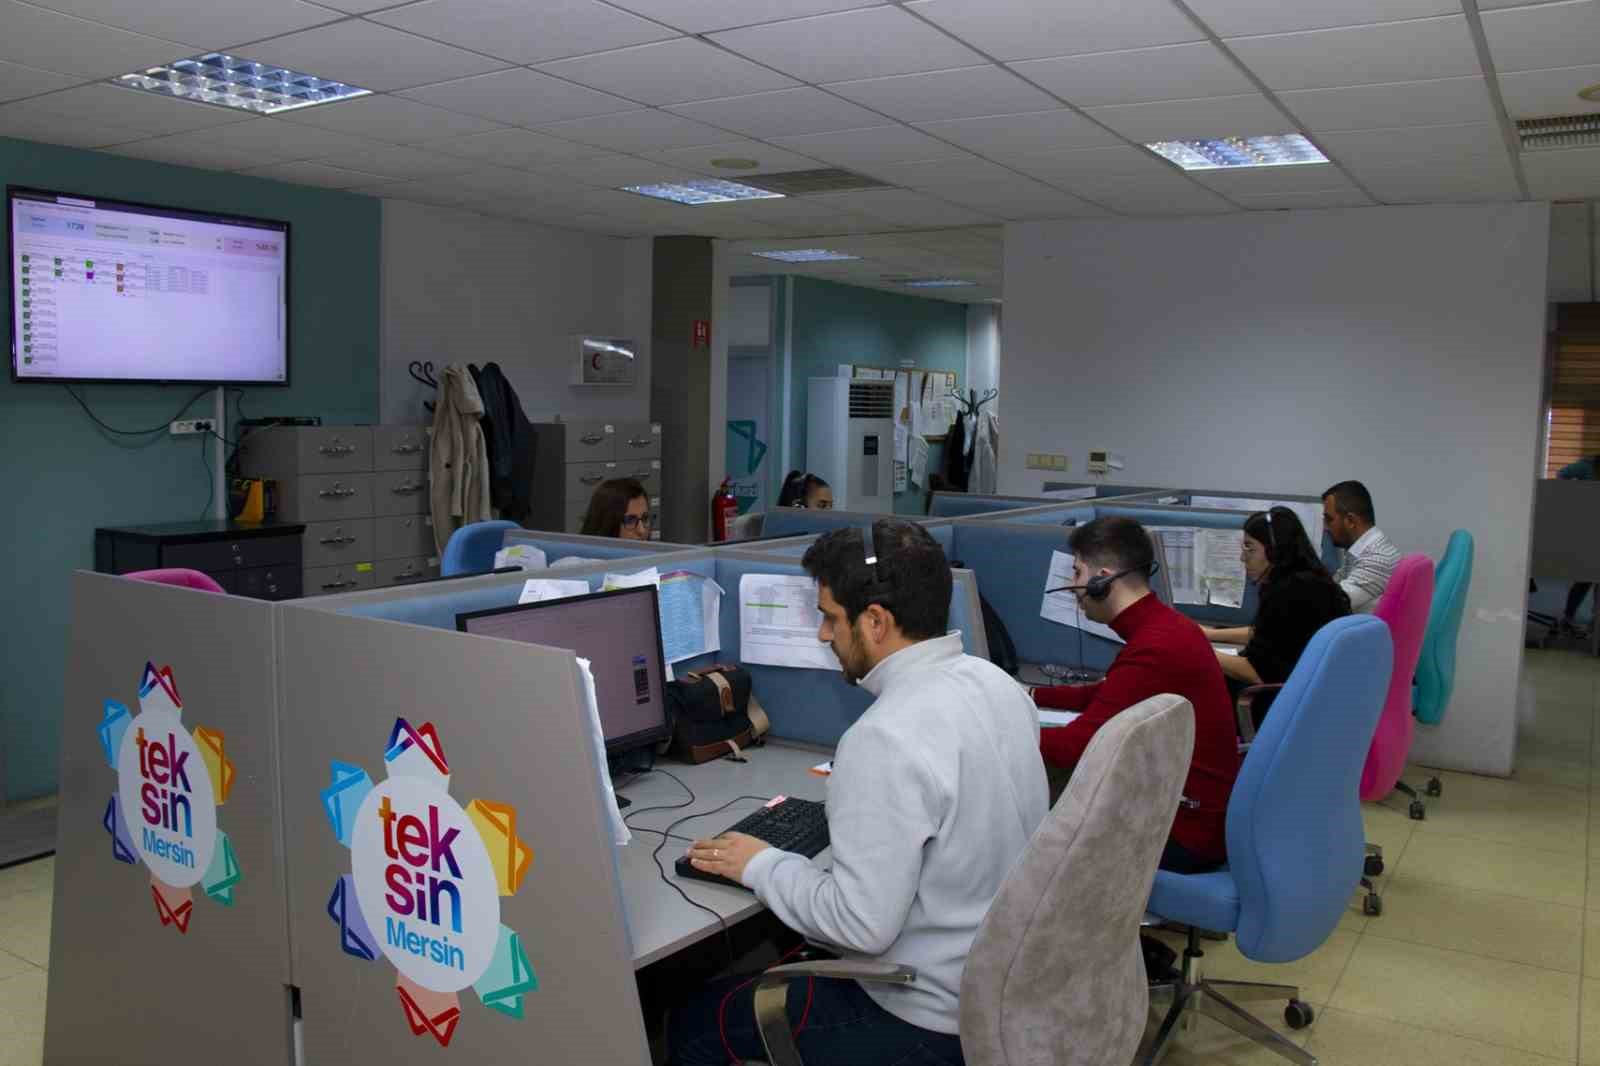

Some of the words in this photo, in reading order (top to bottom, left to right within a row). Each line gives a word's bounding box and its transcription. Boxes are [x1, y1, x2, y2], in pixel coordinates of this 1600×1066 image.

[136, 727, 192, 793] tek
[141, 782, 192, 838] sin
[379, 796, 463, 880] tek
[142, 827, 195, 869] Mersin
[385, 864, 463, 934] sin
[385, 916, 464, 971] Mersin
